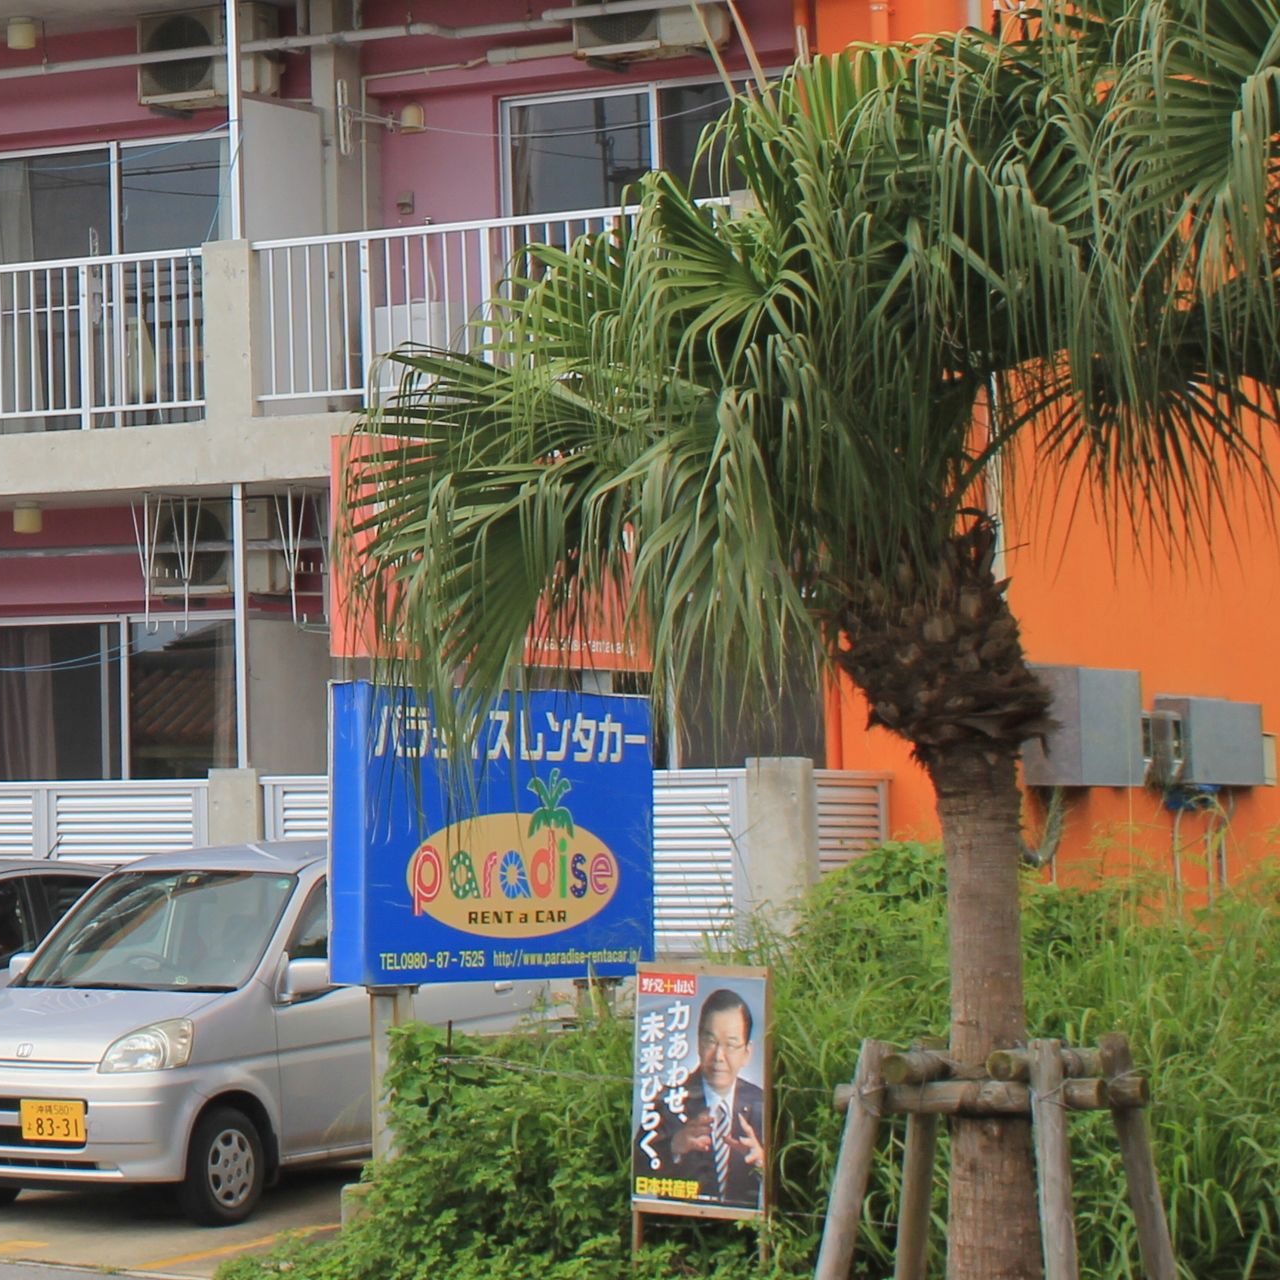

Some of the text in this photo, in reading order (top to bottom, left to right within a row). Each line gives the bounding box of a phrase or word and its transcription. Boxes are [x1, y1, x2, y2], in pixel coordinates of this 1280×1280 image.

[411, 828, 614, 917] paradise
[468, 910, 567, 925] RENT a CAR
[664, 1000, 691, 1123] 力あわせ、
[639, 1011, 666, 1171] 未来ひらく。
[36, 1117, 79, 1137] 83-31
[635, 1176, 700, 1200] 日本共産党
